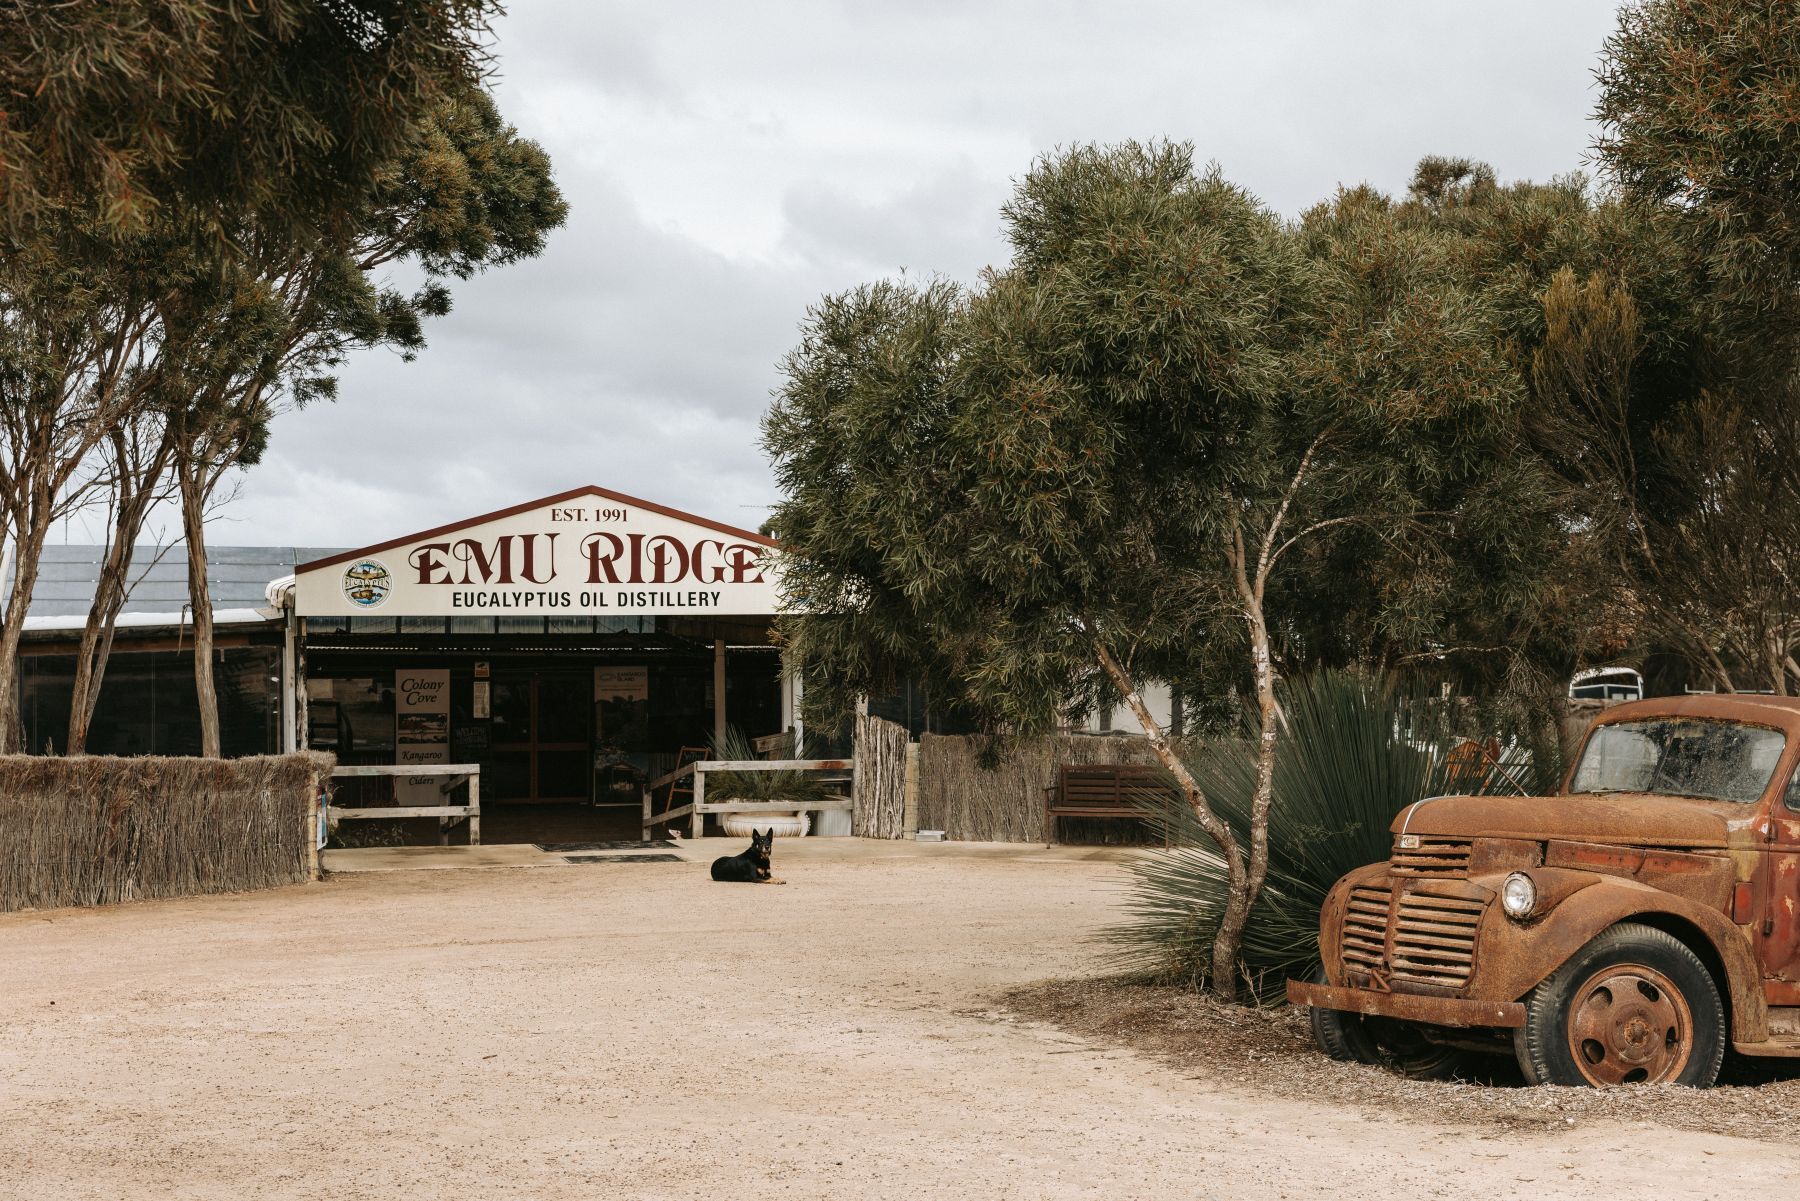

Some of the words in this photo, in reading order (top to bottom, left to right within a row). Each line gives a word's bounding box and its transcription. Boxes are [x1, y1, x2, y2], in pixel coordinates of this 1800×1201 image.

[551, 508, 588, 522] EST.
[595, 508, 629, 523] 1991
[408, 532, 560, 584] EMU
[579, 532, 766, 584] RIDGE
[453, 592, 571, 608] EUCALYPTUS
[580, 591, 608, 608] OIL
[618, 591, 721, 607] DISTILLERY
[401, 678, 444, 693] Colony
[406, 691, 438, 706] Cove
[402, 751, 442, 761] Kangaroo
[409, 775, 434, 786] Ciders
